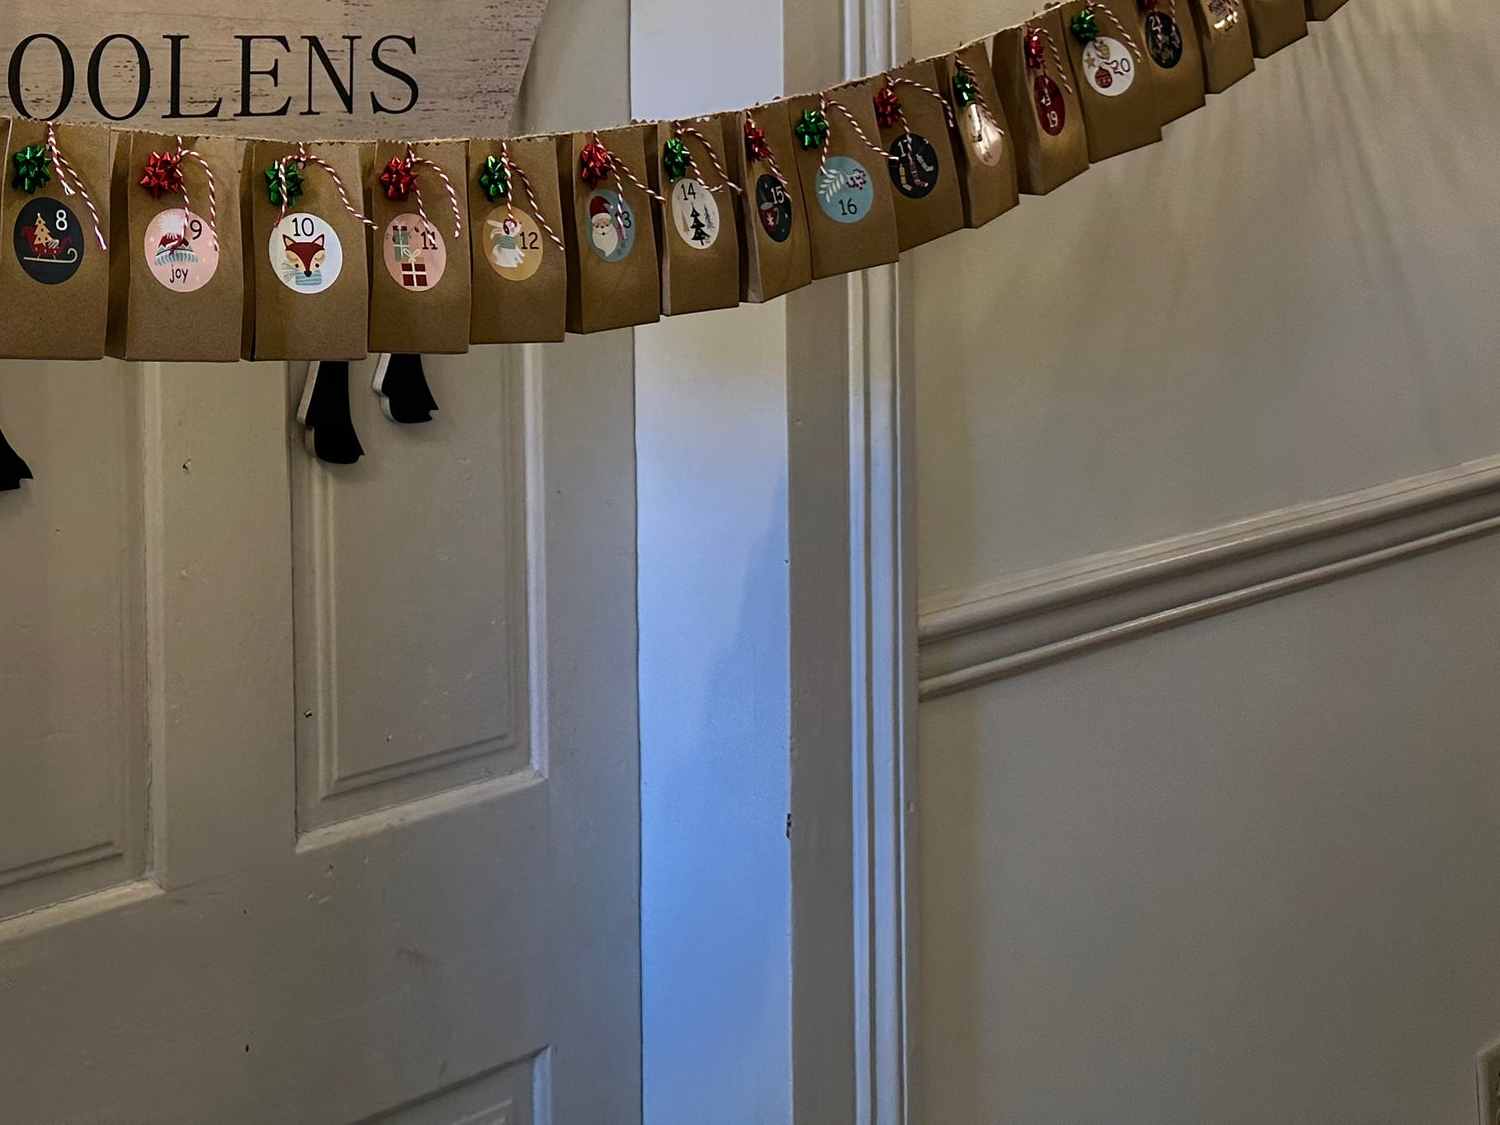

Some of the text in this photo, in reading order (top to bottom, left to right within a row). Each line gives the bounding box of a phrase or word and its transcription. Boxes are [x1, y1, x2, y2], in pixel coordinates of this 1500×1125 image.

[1109, 58, 1131, 75] 20
[1046, 111, 1059, 128] 19
[681, 183, 697, 201] 14
[770, 185, 785, 204] 15
[838, 198, 858, 217] 16
[55, 209, 67, 231] 8
[190, 219, 202, 239] 9
[291, 217, 315, 238] 10
[614, 211, 632, 228] 3
[420, 231, 438, 250] 11
[520, 231, 539, 250] 12
[169, 263, 189, 283] joy
